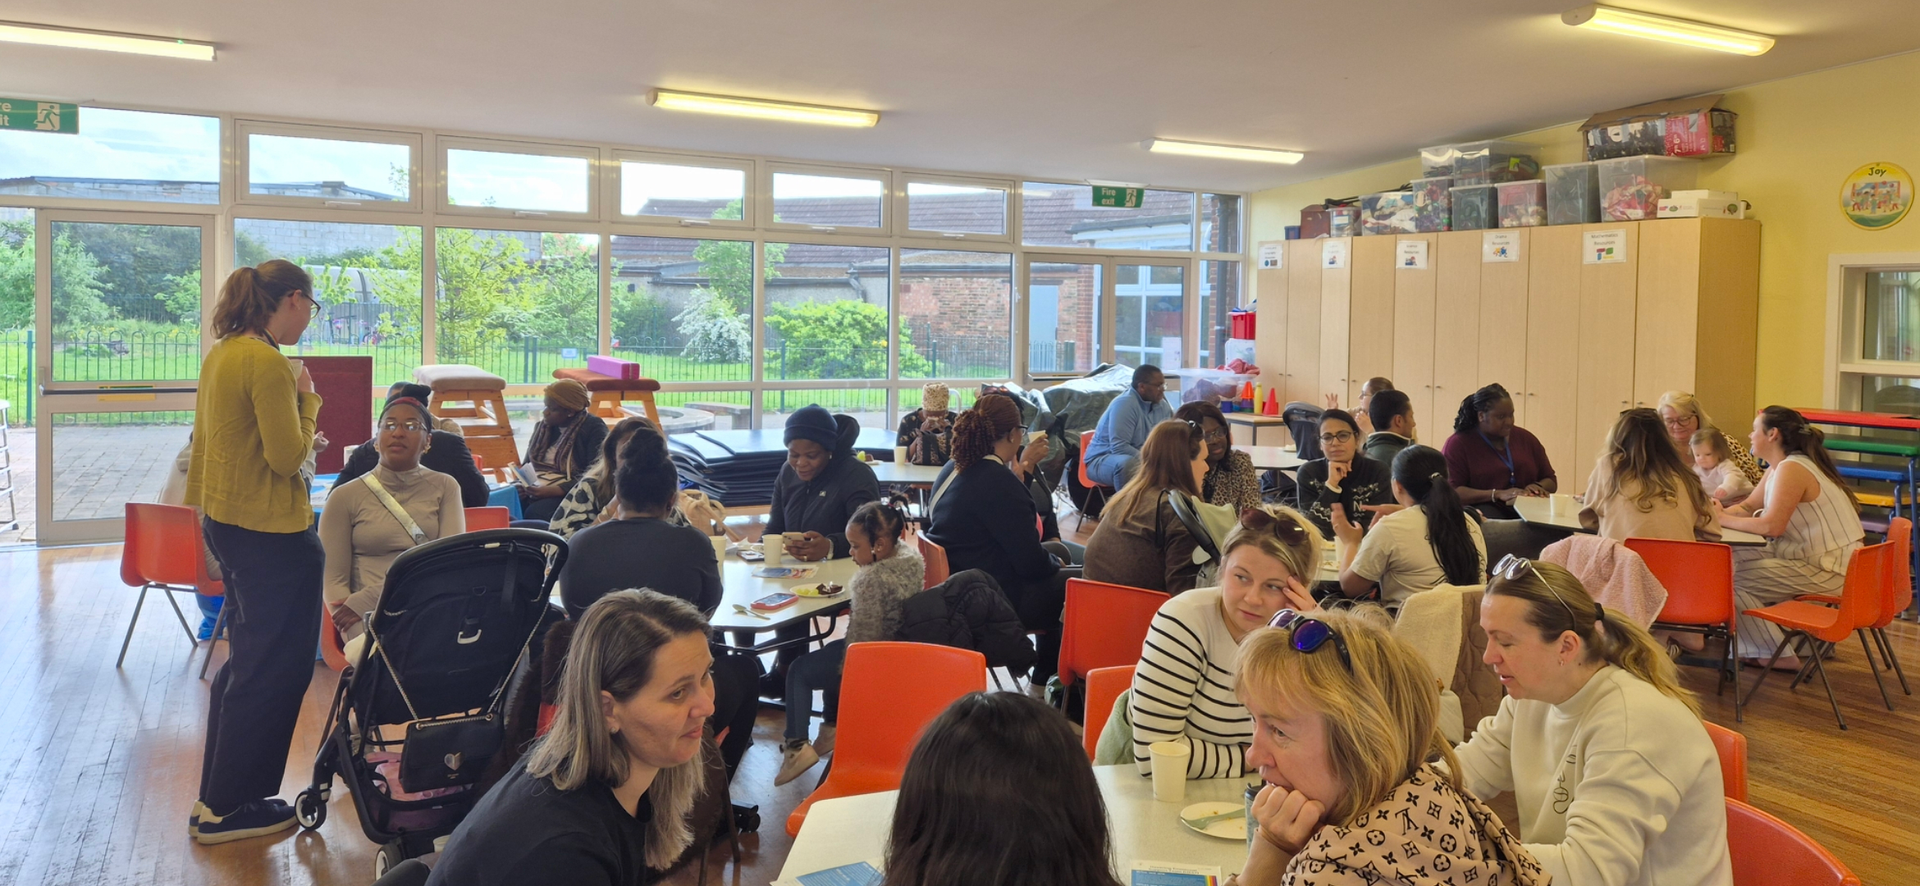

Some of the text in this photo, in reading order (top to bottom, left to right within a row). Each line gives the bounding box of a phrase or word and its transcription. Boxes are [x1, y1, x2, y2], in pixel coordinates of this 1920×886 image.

[1868, 167, 1887, 177] Joy
[1102, 187, 1116, 196] Fire
[1102, 197, 1115, 205] exit
